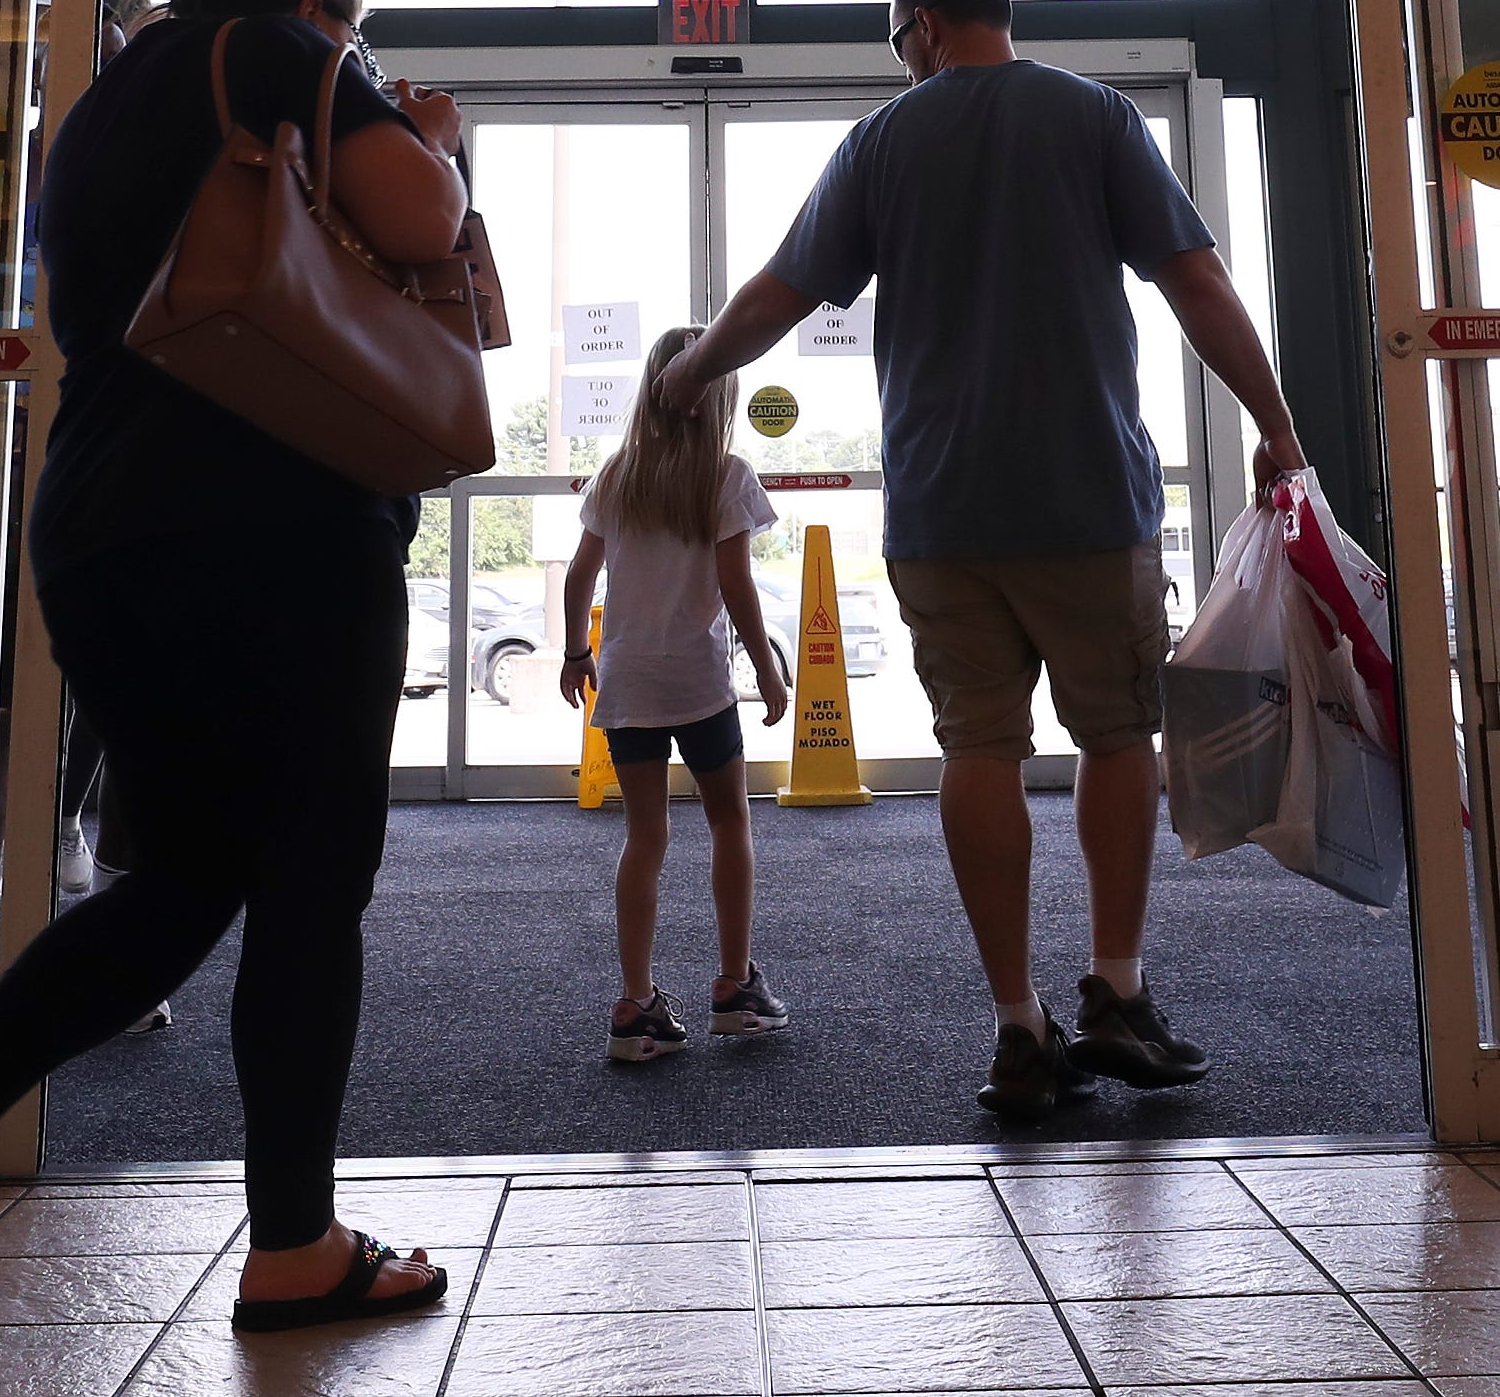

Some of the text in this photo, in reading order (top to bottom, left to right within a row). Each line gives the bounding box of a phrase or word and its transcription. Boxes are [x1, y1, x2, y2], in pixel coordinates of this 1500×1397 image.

[822, 303, 846, 313] OU
[588, 308, 613, 319] OUT
[826, 319, 844, 329] OF
[593, 324, 610, 335] OF
[1445, 321, 1461, 340] IN
[813, 335, 858, 345] ORDER
[580, 340, 625, 353] ORDER
[752, 395, 795, 404] AUTOMATIC
[750, 406, 797, 417] CAUTION
[800, 477, 817, 486] PUSH
[818, 476, 826, 485] TO
[827, 475, 843, 485] OPEN
[808, 642, 835, 653] CAUTION
[811, 700, 836, 710] WET
[804, 711, 843, 721] FLOOR
[810, 727, 837, 737] PISO
[799, 738, 850, 748] MOJADO
